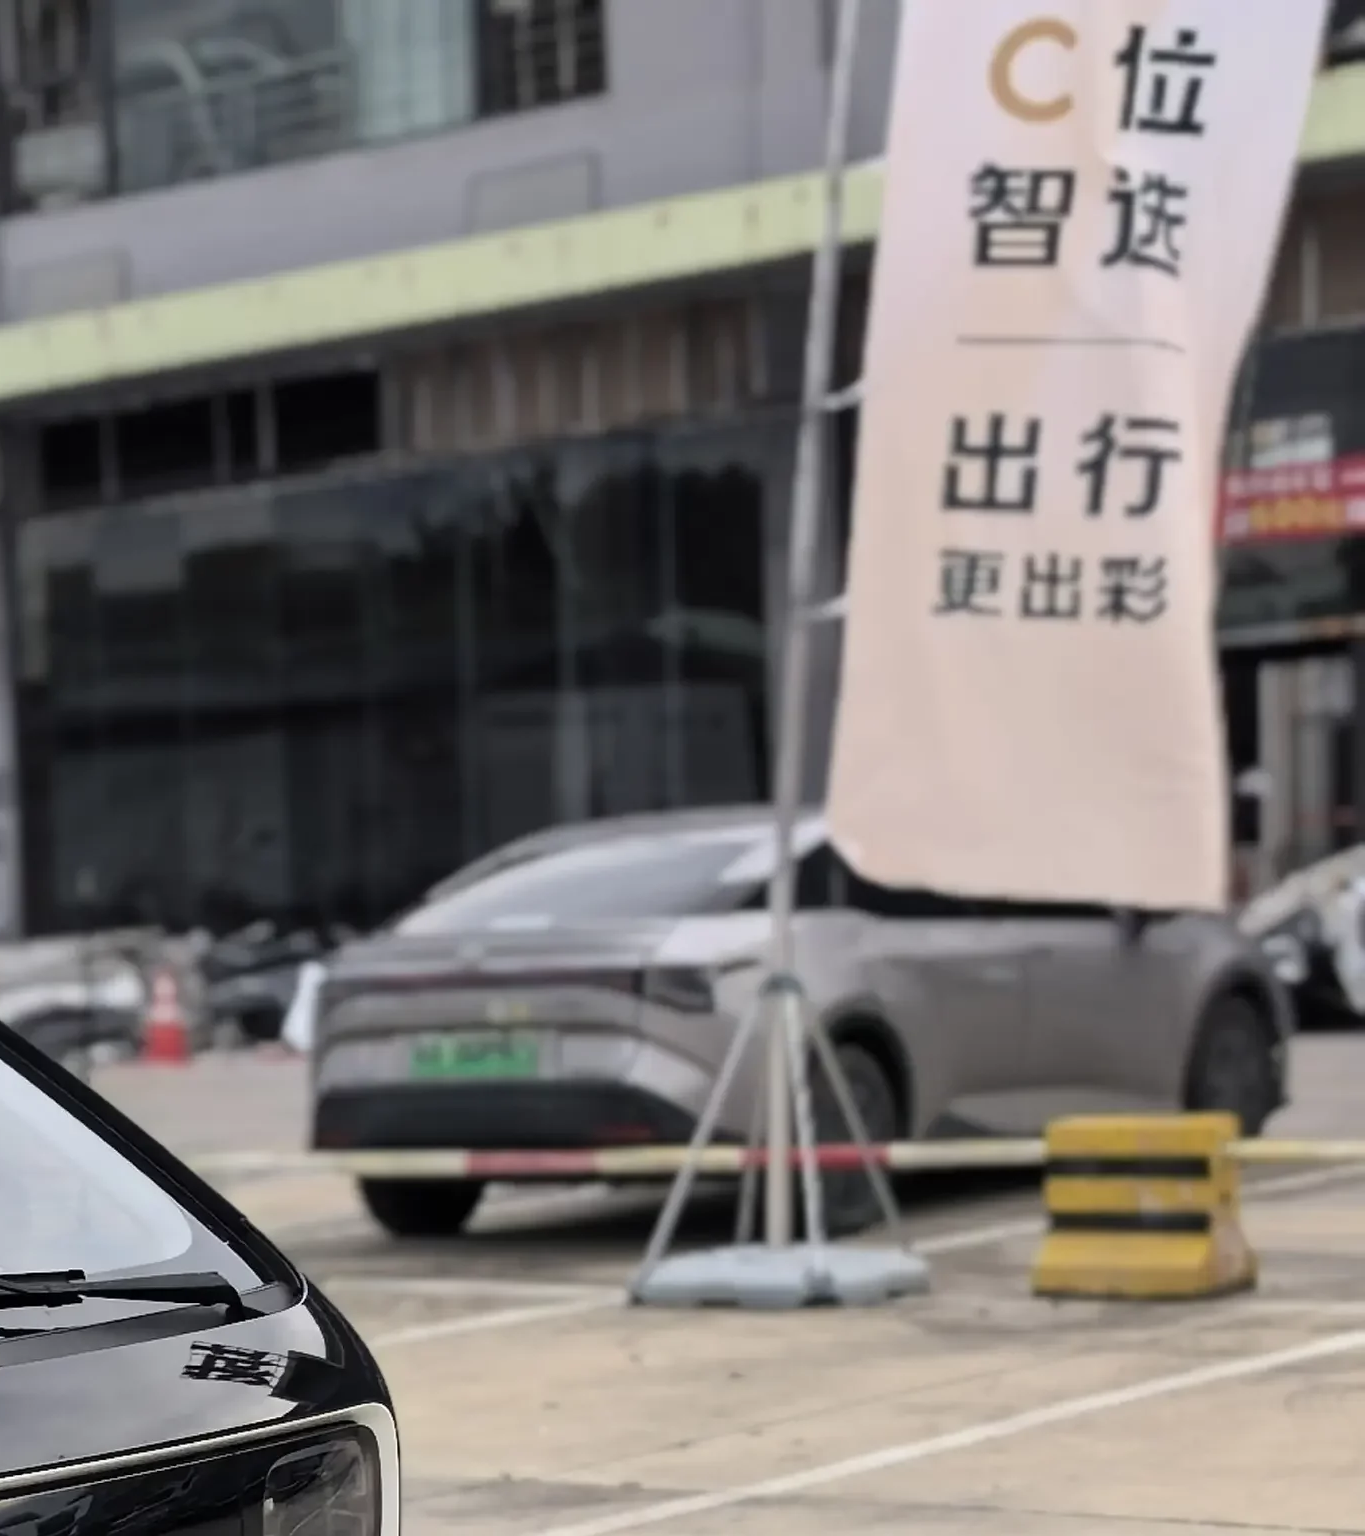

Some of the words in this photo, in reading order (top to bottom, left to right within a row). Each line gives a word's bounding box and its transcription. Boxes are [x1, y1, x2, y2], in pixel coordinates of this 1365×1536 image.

[988, 17, 1217, 136] C位
[967, 160, 1188, 279] 智选
[940, 411, 1183, 519] 出行
[932, 547, 1169, 625] 更出彩
